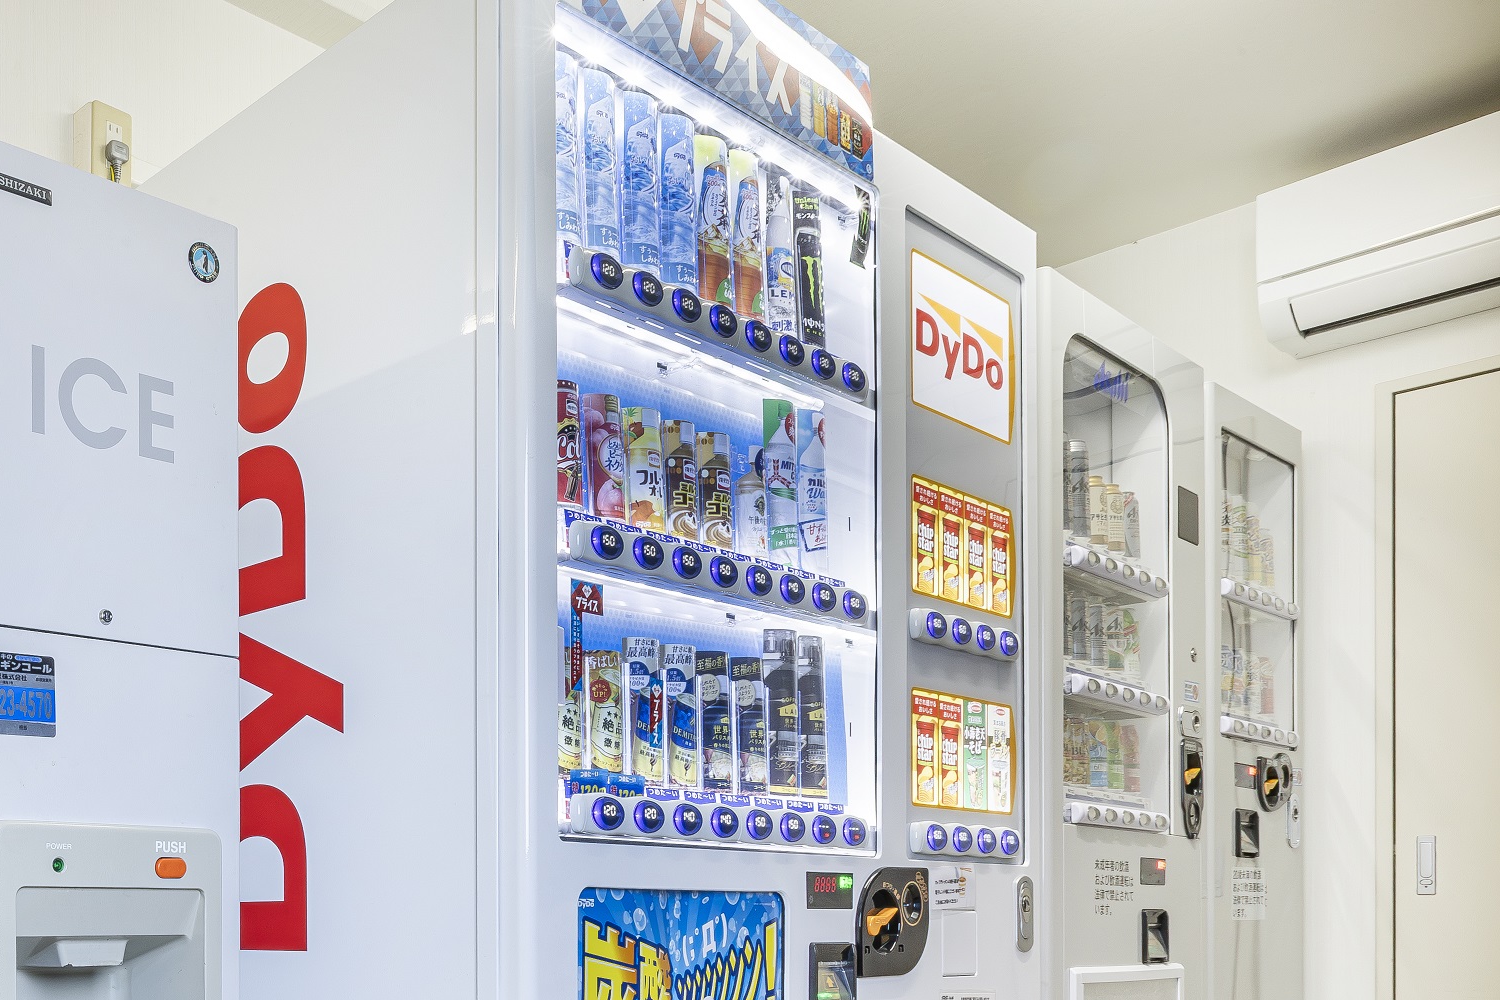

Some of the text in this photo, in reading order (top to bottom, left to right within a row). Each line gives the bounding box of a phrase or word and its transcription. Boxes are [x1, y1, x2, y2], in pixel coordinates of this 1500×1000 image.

[602, 263, 615, 277] 120
[643, 281, 656, 294] 120
[682, 298, 694, 310] 120
[772, 319, 796, 332] 刺激
[916, 308, 1003, 391] DyDo
[31, 344, 175, 464] ICE
[918, 523, 934, 540] chip
[602, 534, 615, 547] 150
[918, 536, 934, 552] star
[944, 531, 958, 548] chip
[643, 545, 656, 557] 150
[943, 544, 958, 560] star
[969, 540, 983, 556] chip
[682, 554, 694, 567] 150
[969, 552, 983, 567] star
[992, 547, 1006, 563] chip
[719, 564, 731, 575] 150
[992, 560, 1006, 575] star
[575, 596, 599, 613] プライス
[627, 646, 656, 659] 最高峰
[665, 653, 692, 665] 最高峰
[713, 725, 729, 735] 世界
[749, 729, 764, 739] 世界
[918, 733, 933, 750] chip
[942, 738, 958, 754] chip
[917, 747, 933, 762] star
[942, 751, 957, 766] star
[603, 805, 616, 816] 120
[644, 808, 657, 819] 120
[683, 811, 695, 822] 140
[720, 815, 731, 825] 140
[754, 817, 766, 827] 150
[46, 842, 72, 850] POWER
[155, 841, 187, 854] PUSH
